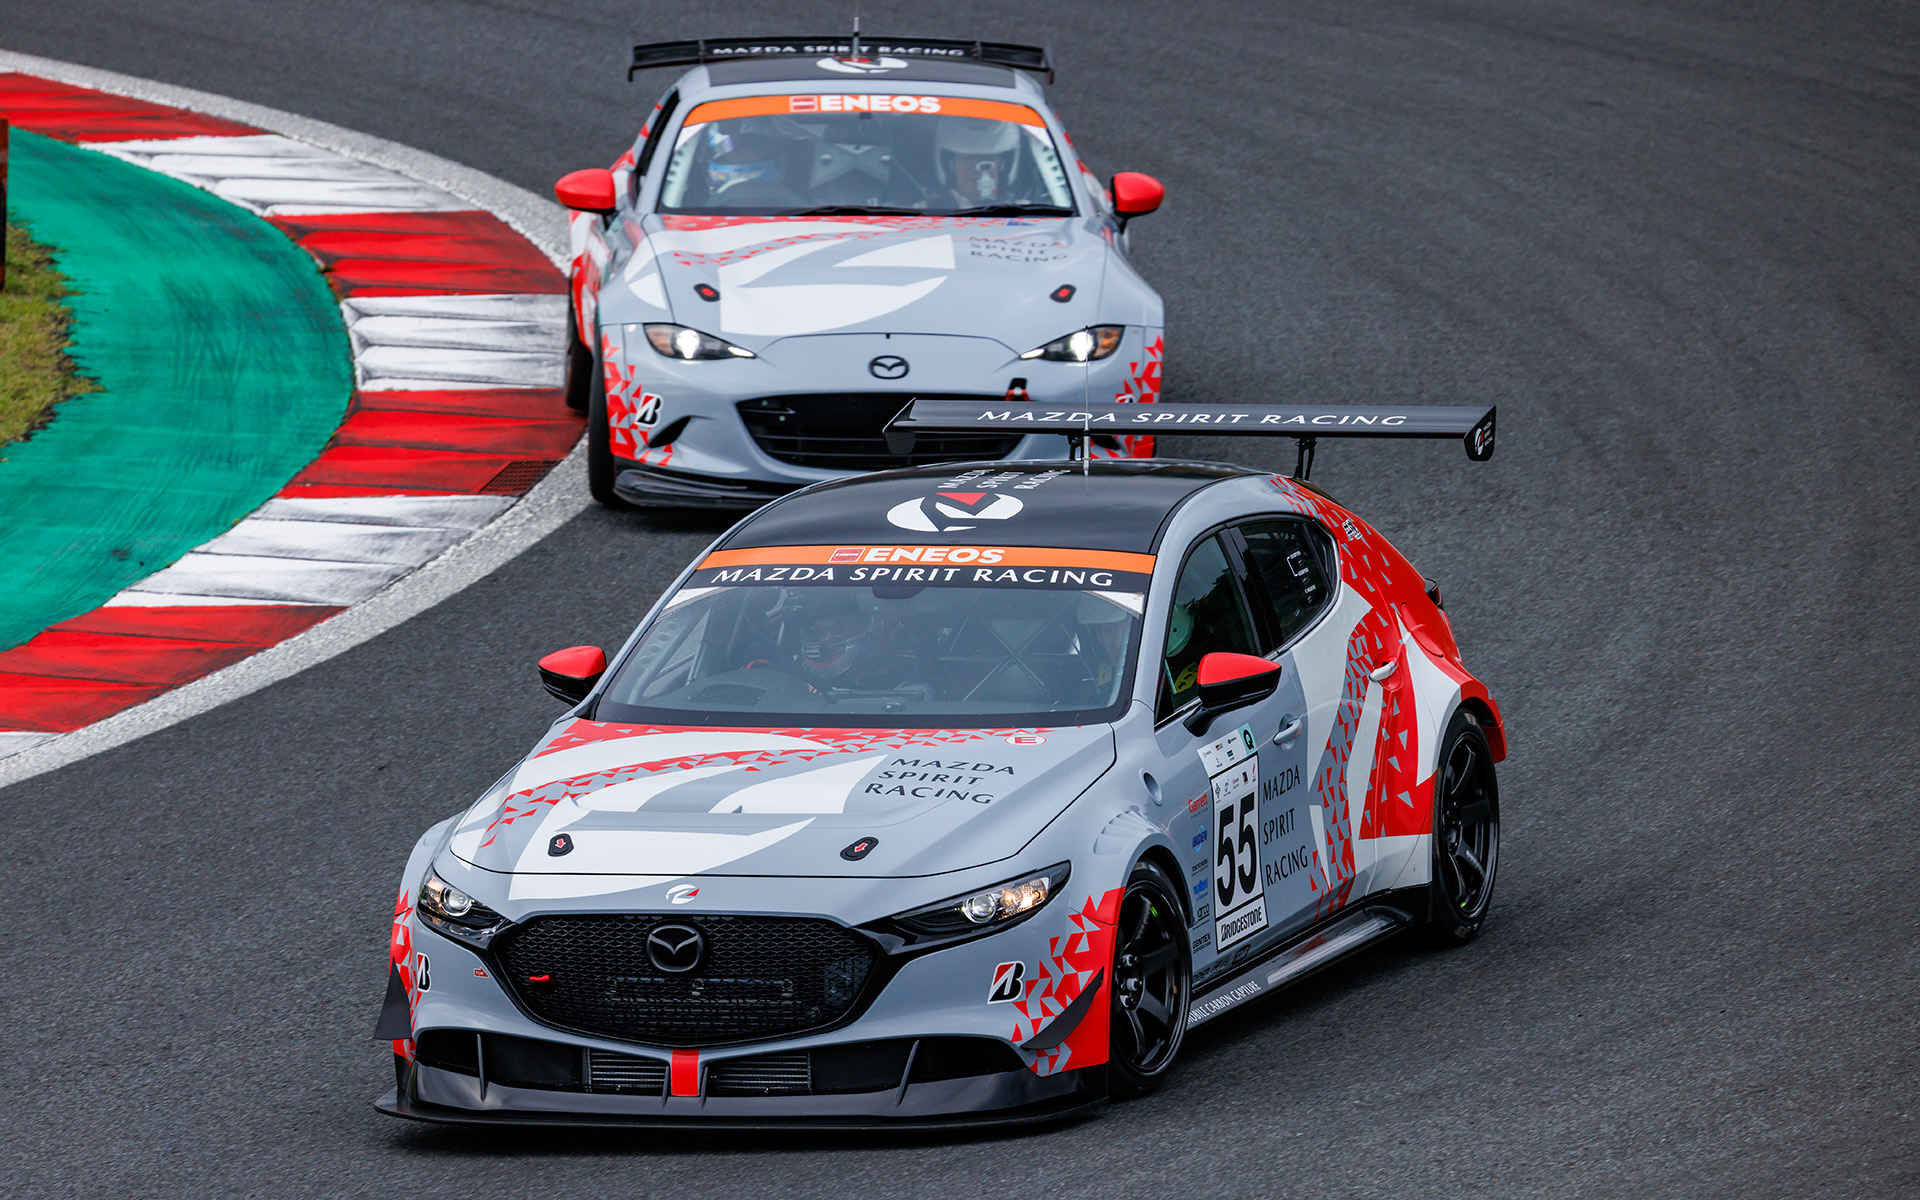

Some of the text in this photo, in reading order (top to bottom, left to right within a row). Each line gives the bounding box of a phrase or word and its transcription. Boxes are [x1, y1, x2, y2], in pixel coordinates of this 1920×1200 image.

[713, 45, 964, 56] MAZDA SPIRT RACING
[820, 95, 941, 113] ENEOS
[970, 251, 1068, 262] RACING
[971, 243, 1045, 254] SPIRIT
[977, 411, 1407, 426] MAZDA SPIRIT RACING
[937, 468, 995, 489] MAZDA
[976, 471, 1024, 489] SPIRIT
[863, 548, 1005, 564] ENEOS
[711, 567, 1113, 586] MAZDA SPIRIT RACING
[1242, 729, 1255, 750] Q
[891, 758, 1015, 775] MAZDA
[878, 770, 984, 785] SPIRIT
[1262, 764, 1300, 805] MAZDA
[864, 783, 994, 804] RACING
[1188, 792, 1208, 813] Garrett
[1263, 808, 1294, 845] SPIRIT
[1217, 791, 1257, 906] 55
[1265, 845, 1308, 887] RACING
[1221, 906, 1262, 942] BRIDGESTONE
[1204, 993, 1235, 1013] CARBON
[1230, 980, 1262, 1000] CAPTURE
